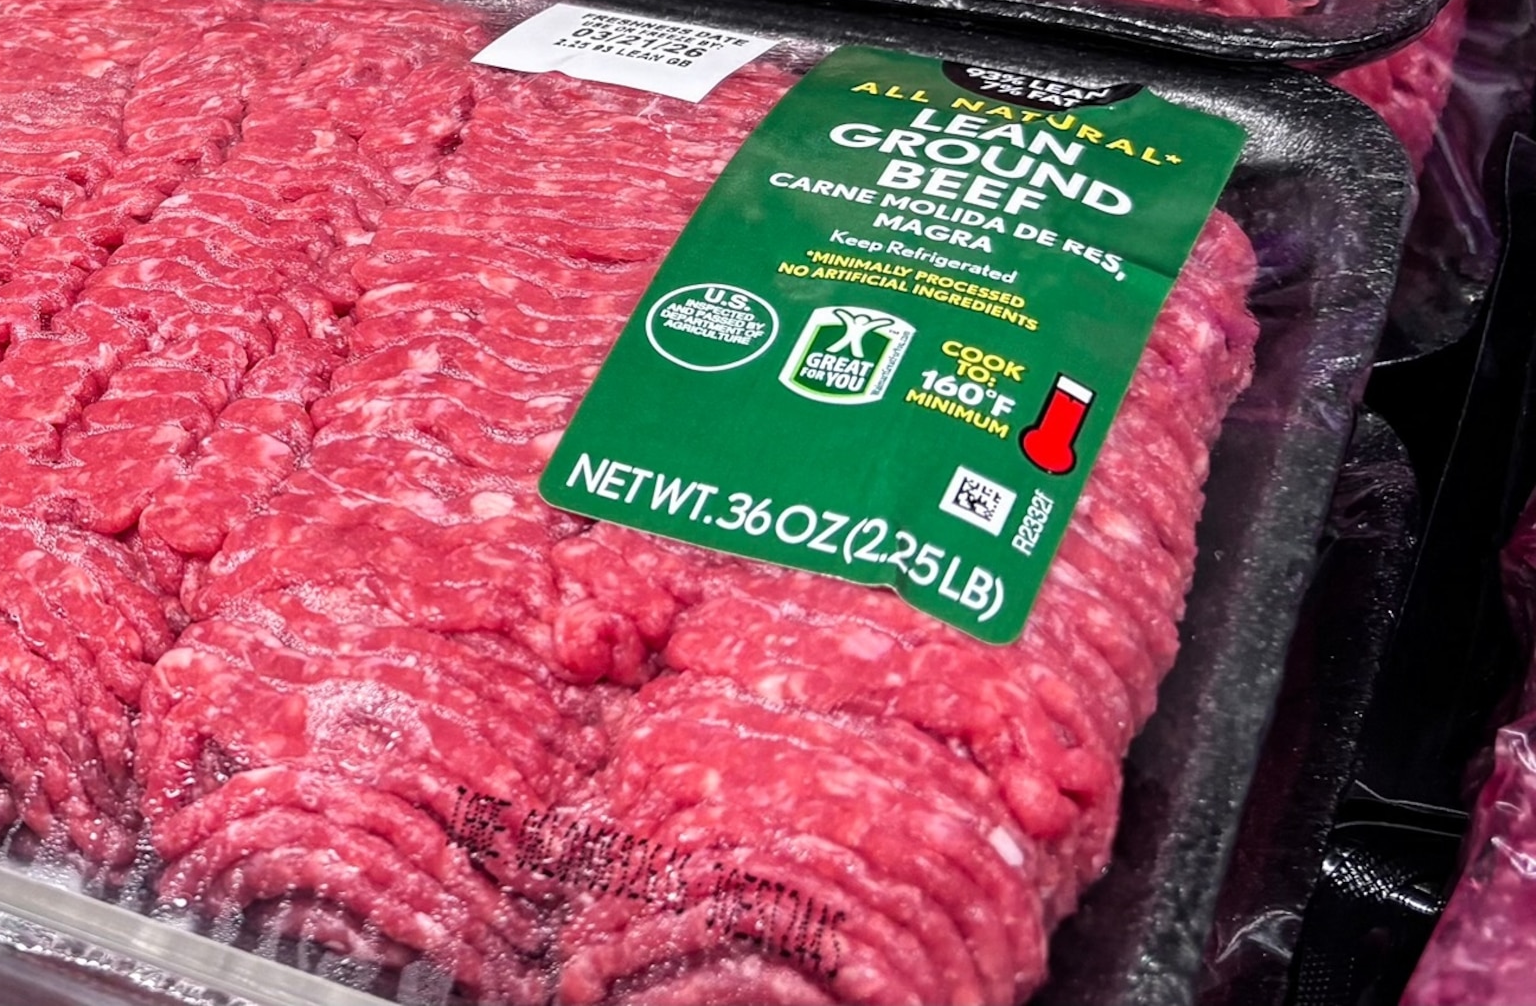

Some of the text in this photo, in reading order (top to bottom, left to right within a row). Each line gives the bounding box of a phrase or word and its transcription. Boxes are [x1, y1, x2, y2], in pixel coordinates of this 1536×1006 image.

[571, 27, 708, 60] 03/21/26
[581, 13, 751, 48] FRESHNESS DATE
[615, 47, 665, 64] LEAN
[851, 80, 931, 104] ALL
[966, 67, 1110, 101] 93% LEAN
[980, 80, 1079, 110] 7% FAT
[909, 107, 1086, 166] LEAN
[828, 122, 1133, 217] GROUND
[876, 159, 1048, 216] BEEF
[768, 172, 1128, 283] CARNE MOLIDA DE RES,
[872, 212, 994, 254] MAGRA
[829, 228, 1018, 285] Keep Refrigerated
[702, 287, 752, 312] U.S.
[777, 261, 1040, 332] NO ARTIFICIAL INGREDIENTS
[915, 269, 1027, 309] PROCESSED
[660, 308, 765, 340] DEPARTMENT OF
[666, 302, 766, 332] AND PASSED BY
[685, 298, 756, 322] INSPECTED
[663, 318, 751, 346] AGRICULTURE
[805, 352, 875, 378] GREAT
[941, 340, 1027, 382] COOK
[956, 359, 998, 388] TO:
[799, 366, 865, 392] FOR YOU
[921, 368, 1017, 418] 160°F
[904, 388, 1011, 440] MINIMUM
